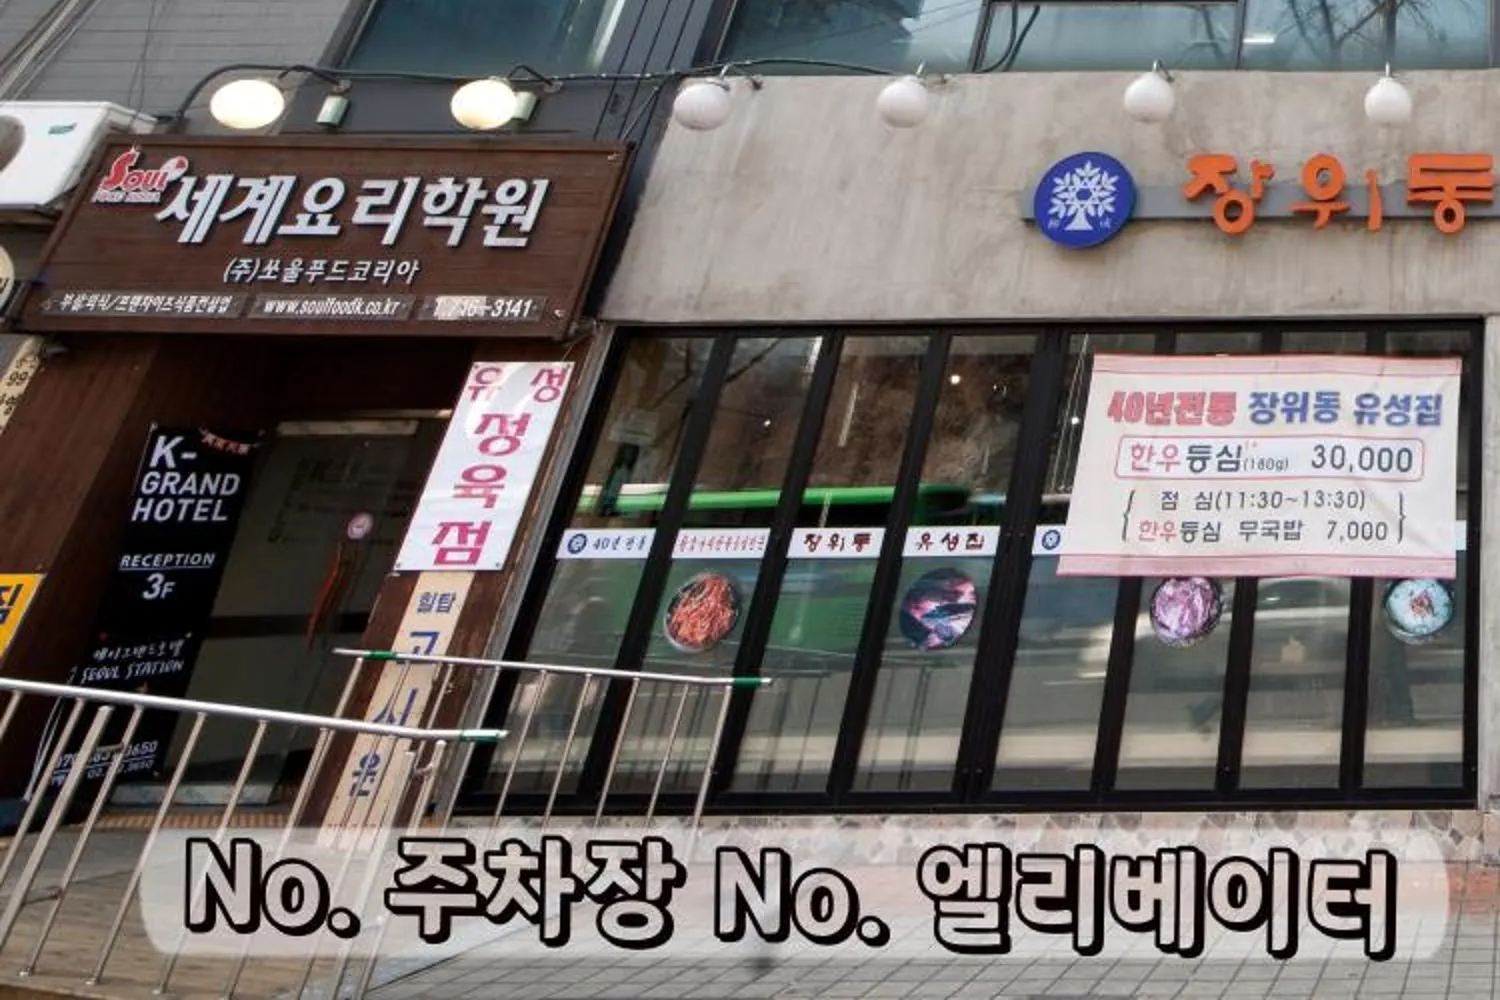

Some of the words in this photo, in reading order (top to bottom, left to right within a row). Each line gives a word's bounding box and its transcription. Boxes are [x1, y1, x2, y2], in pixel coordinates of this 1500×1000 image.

[1183, 152, 1494, 234] 장위동
[154, 174, 549, 249] 세계요리학원
[222, 257, 420, 285] (주)쏘울푸드코리아
[1106, 391, 1237, 426] 40년전통
[1248, 391, 1342, 426] 장위동
[1353, 392, 1443, 427] 유성집
[149, 435, 198, 469] K-
[1311, 444, 1414, 475] 30,000
[140, 471, 241, 496] GRAND
[430, 411, 532, 566] 정육점
[131, 497, 229, 523] HOTEL
[803, 533, 872, 552] 장위동
[915, 532, 986, 551] 유성집
[1139, 520, 1221, 543] 한우등심
[1238, 520, 1305, 542] 무국밥
[1326, 521, 1388, 543] 7,000
[120, 552, 216, 568] RECEPTION
[142, 572, 176, 600] 3F
[416, 591, 456, 614] 힐탑
